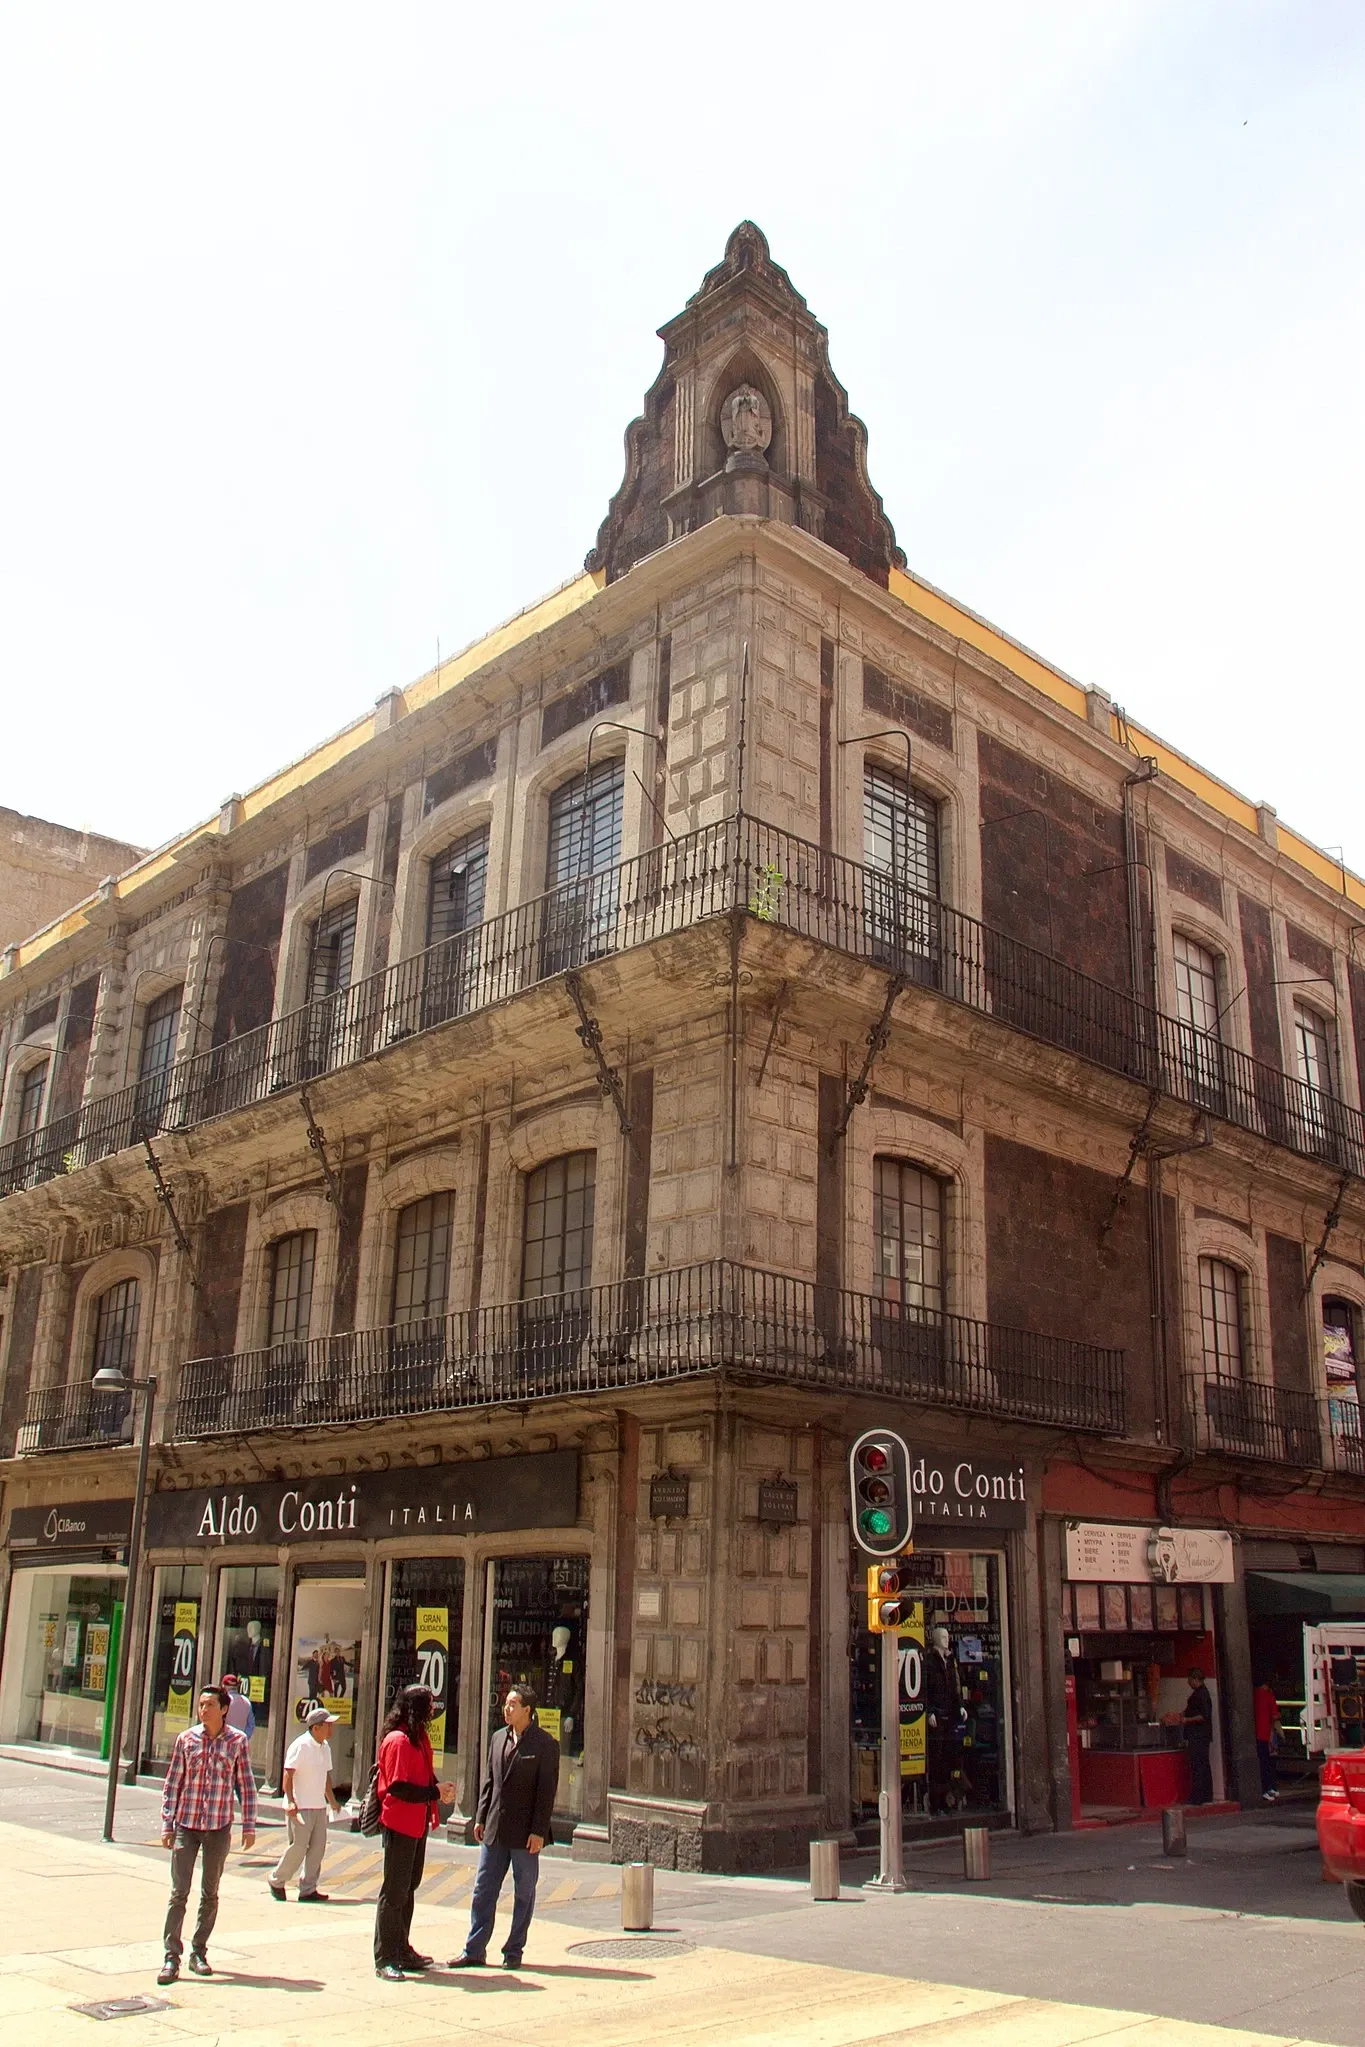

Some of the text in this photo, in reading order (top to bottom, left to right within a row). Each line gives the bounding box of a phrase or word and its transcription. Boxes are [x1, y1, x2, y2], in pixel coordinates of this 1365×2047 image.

[912, 1459, 1026, 1501] do Conti
[197, 1485, 473, 1536] Aldo Conti ITALIA
[919, 1501, 987, 1518] ITALIA
[423, 1614, 441, 1623] GRAN
[903, 1728, 920, 1738] TODA
